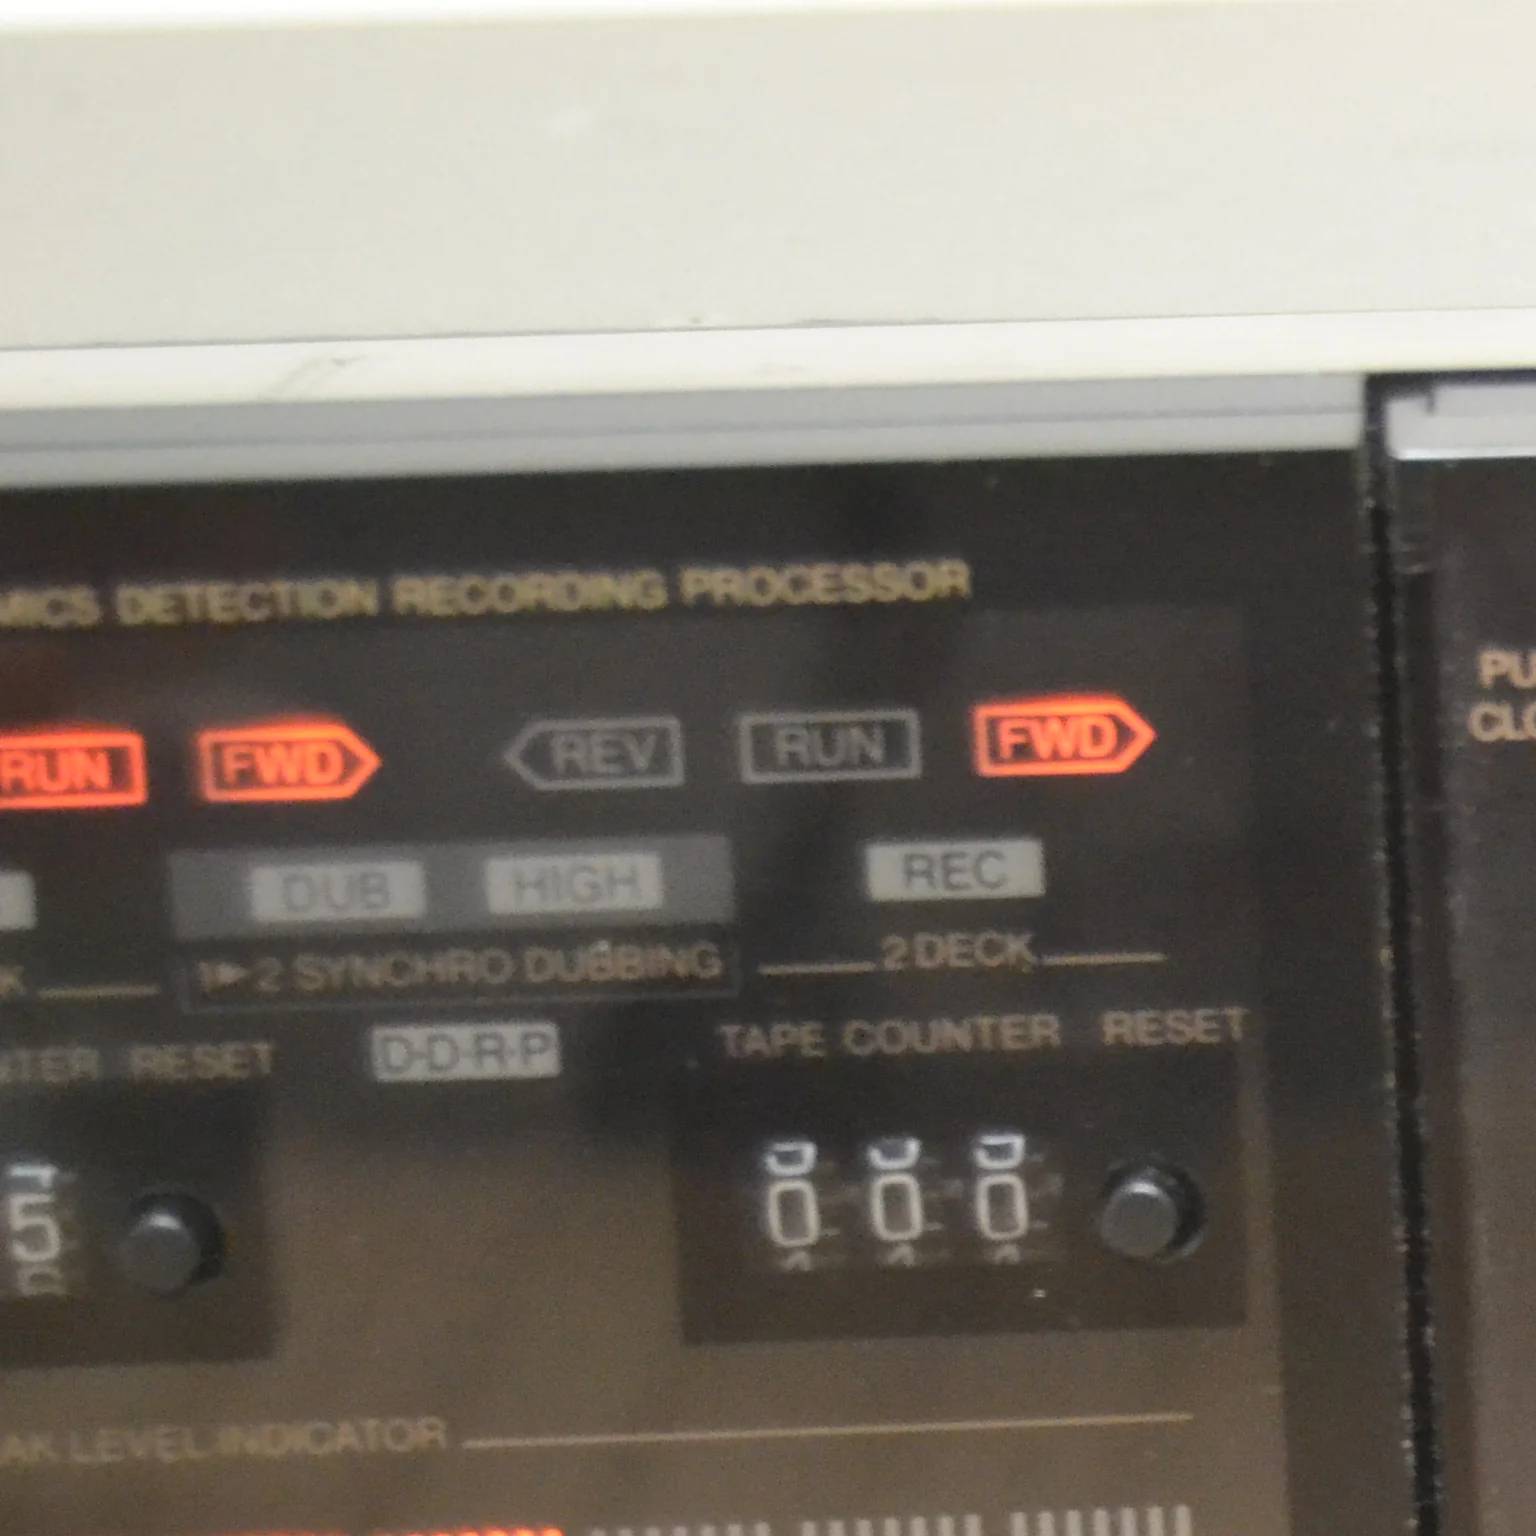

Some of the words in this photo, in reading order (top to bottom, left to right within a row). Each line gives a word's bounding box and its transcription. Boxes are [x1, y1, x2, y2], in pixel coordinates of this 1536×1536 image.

[115, 578, 379, 625] DETECTION
[392, 570, 668, 616] RECORDING
[680, 558, 972, 607] PROCESSOR
[551, 732, 657, 774] REV
[776, 725, 888, 767] RUN
[998, 716, 1117, 760] FWD
[0, 749, 110, 793] RUN
[222, 743, 345, 785] FWD
[513, 864, 642, 905] HIGH
[903, 849, 1010, 891] REC
[281, 871, 391, 914] DUB
[294, 946, 514, 990] SYNCHRO
[525, 939, 722, 985] DUBBING
[717, 1021, 826, 1059] TAPE
[842, 1013, 1063, 1055] COUNTER
[1101, 1006, 1250, 1046] RESET
[129, 1041, 274, 1081] RESET
[70, 1424, 208, 1463] LEVEL
[217, 1416, 448, 1457] INDICATOR
